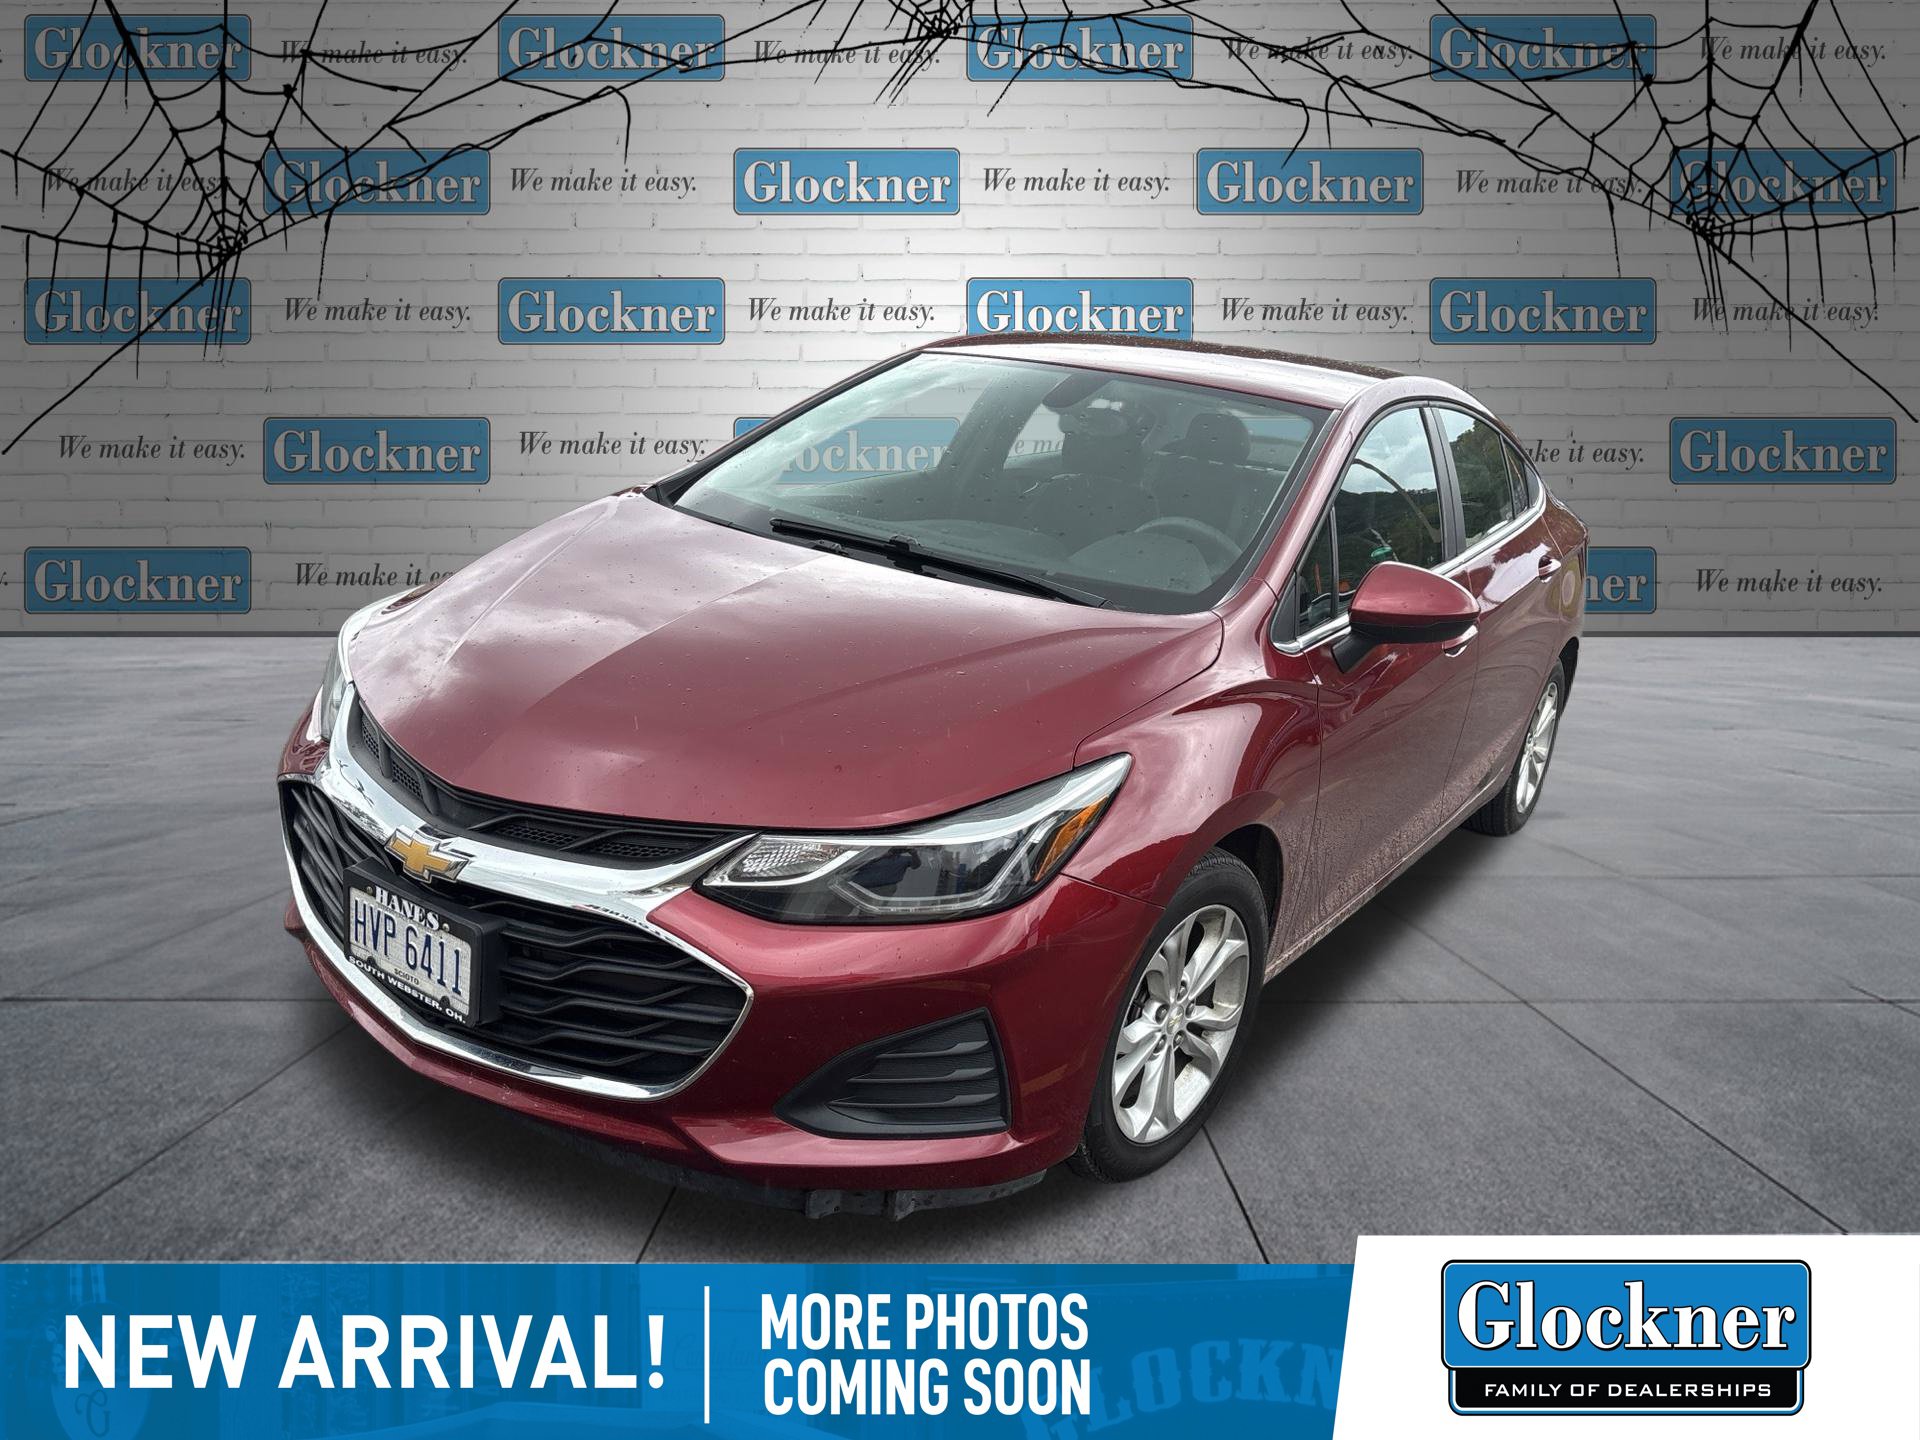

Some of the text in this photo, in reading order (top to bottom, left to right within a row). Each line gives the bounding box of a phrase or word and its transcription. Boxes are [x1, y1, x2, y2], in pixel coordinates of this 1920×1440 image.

[34, 26, 242, 69] Glockner
[321, 39, 384, 64] make
[391, 40, 408, 64] it
[415, 47, 468, 72] easy.
[507, 26, 715, 69] Glockner
[755, 39, 787, 64] We
[794, 39, 857, 64] make
[864, 40, 881, 64] it
[976, 26, 1184, 69] Glockner
[1228, 35, 1260, 60] We
[1337, 36, 1354, 60] it
[1361, 43, 1414, 68] easy.
[1439, 26, 1647, 69] Glockner
[1700, 36, 1732, 61] We
[1809, 37, 1826, 61] it
[1833, 44, 1886, 69] easy.
[86, 167, 149, 192] make
[156, 168, 173, 192] it
[273, 160, 481, 203] Glockner
[511, 167, 697, 200] We make it easy.
[743, 160, 951, 203] Glockner
[984, 167, 1170, 200] We make it easy.
[1206, 160, 1414, 203] Glockner
[1457, 169, 1489, 194] We
[1496, 169, 1559, 194] make
[34, 290, 242, 333] Glockner
[285, 297, 471, 330] We make it easy.
[507, 290, 715, 333] Glockner
[749, 297, 935, 330] We make it easy.
[976, 290, 1184, 333] Glockner
[1222, 297, 1408, 330] We make it easy.
[1439, 290, 1647, 333] Glockner
[1693, 297, 1725, 322] We
[1732, 297, 1795, 322] make
[1802, 298, 1819, 322] it
[60, 434, 246, 467] We make it easy.
[273, 429, 481, 472] Glockner
[520, 430, 706, 463] We make it easy.
[1568, 439, 1585, 463] it
[1592, 446, 1645, 471] easy.
[1679, 429, 1887, 472] Glockner
[34, 559, 242, 602] Glockner
[296, 562, 328, 587] We
[335, 562, 398, 587] make
[405, 563, 422, 587] it
[1697, 568, 1883, 601] We make it easy.
[374, 885, 440, 931] HANES
[354, 898, 463, 996] HVP 6411
[348, 955, 385, 980] SOUTH
[445, 1007, 467, 1024] OH.
